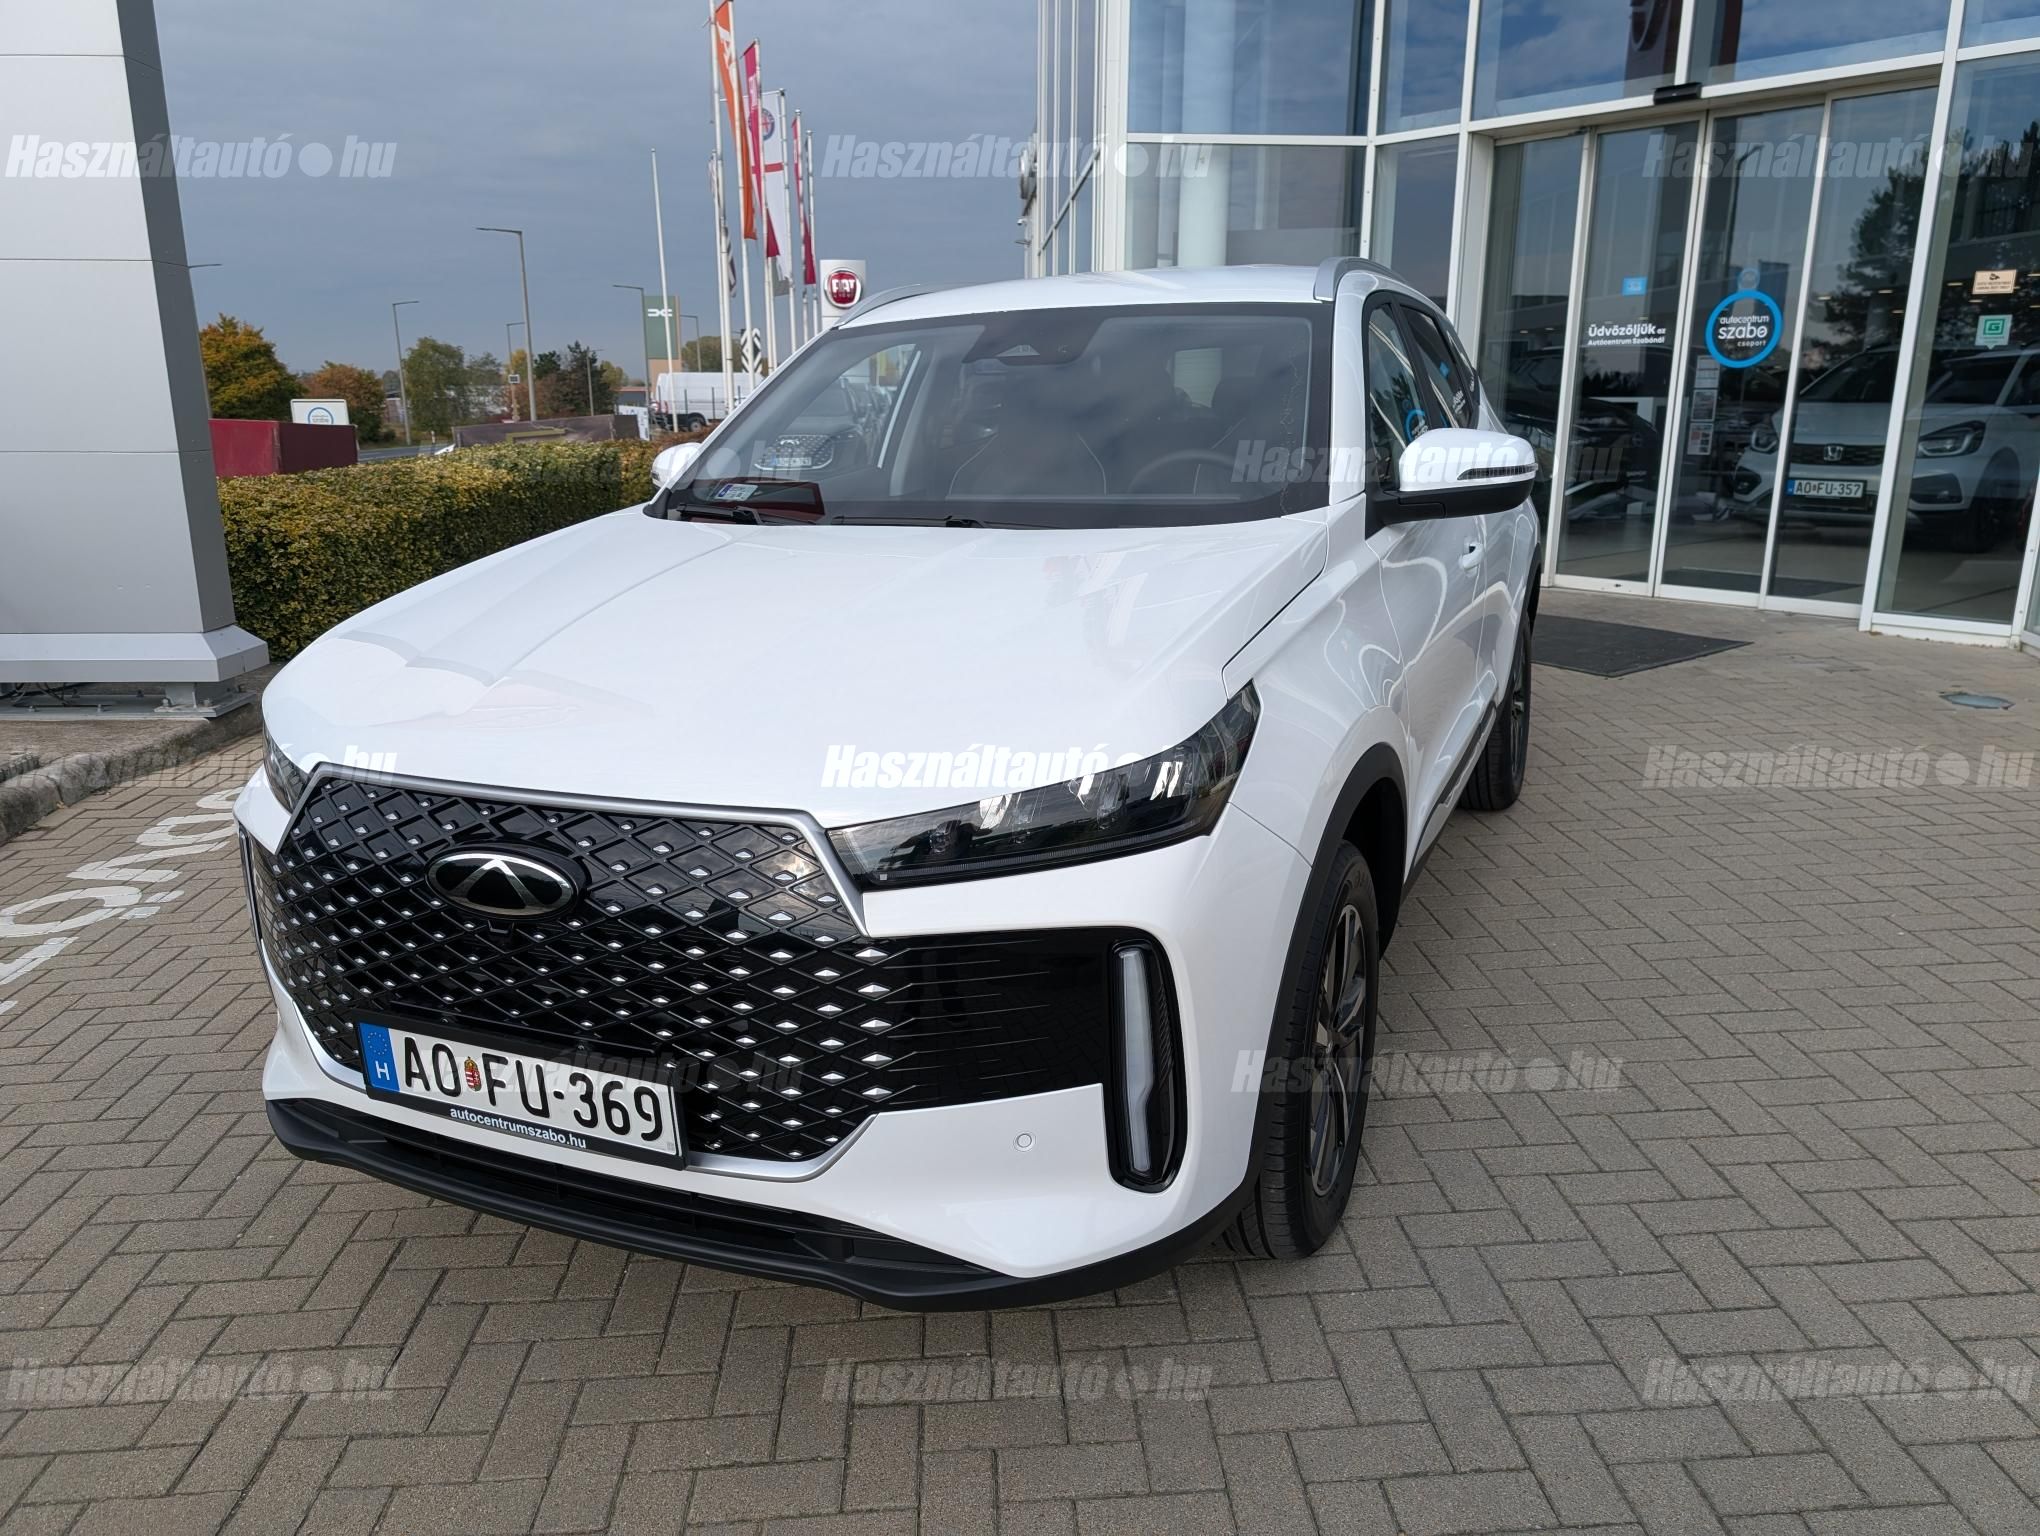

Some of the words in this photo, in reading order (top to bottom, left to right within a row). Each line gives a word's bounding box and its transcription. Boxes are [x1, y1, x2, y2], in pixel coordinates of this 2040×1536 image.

[1816, 482, 1862, 496] FU-357
[375, 1060, 391, 1082] H
[404, 1036, 462, 1098] AO
[481, 1052, 664, 1142] FU-369
[449, 1107, 587, 1150] autocentrumszabo.hu
